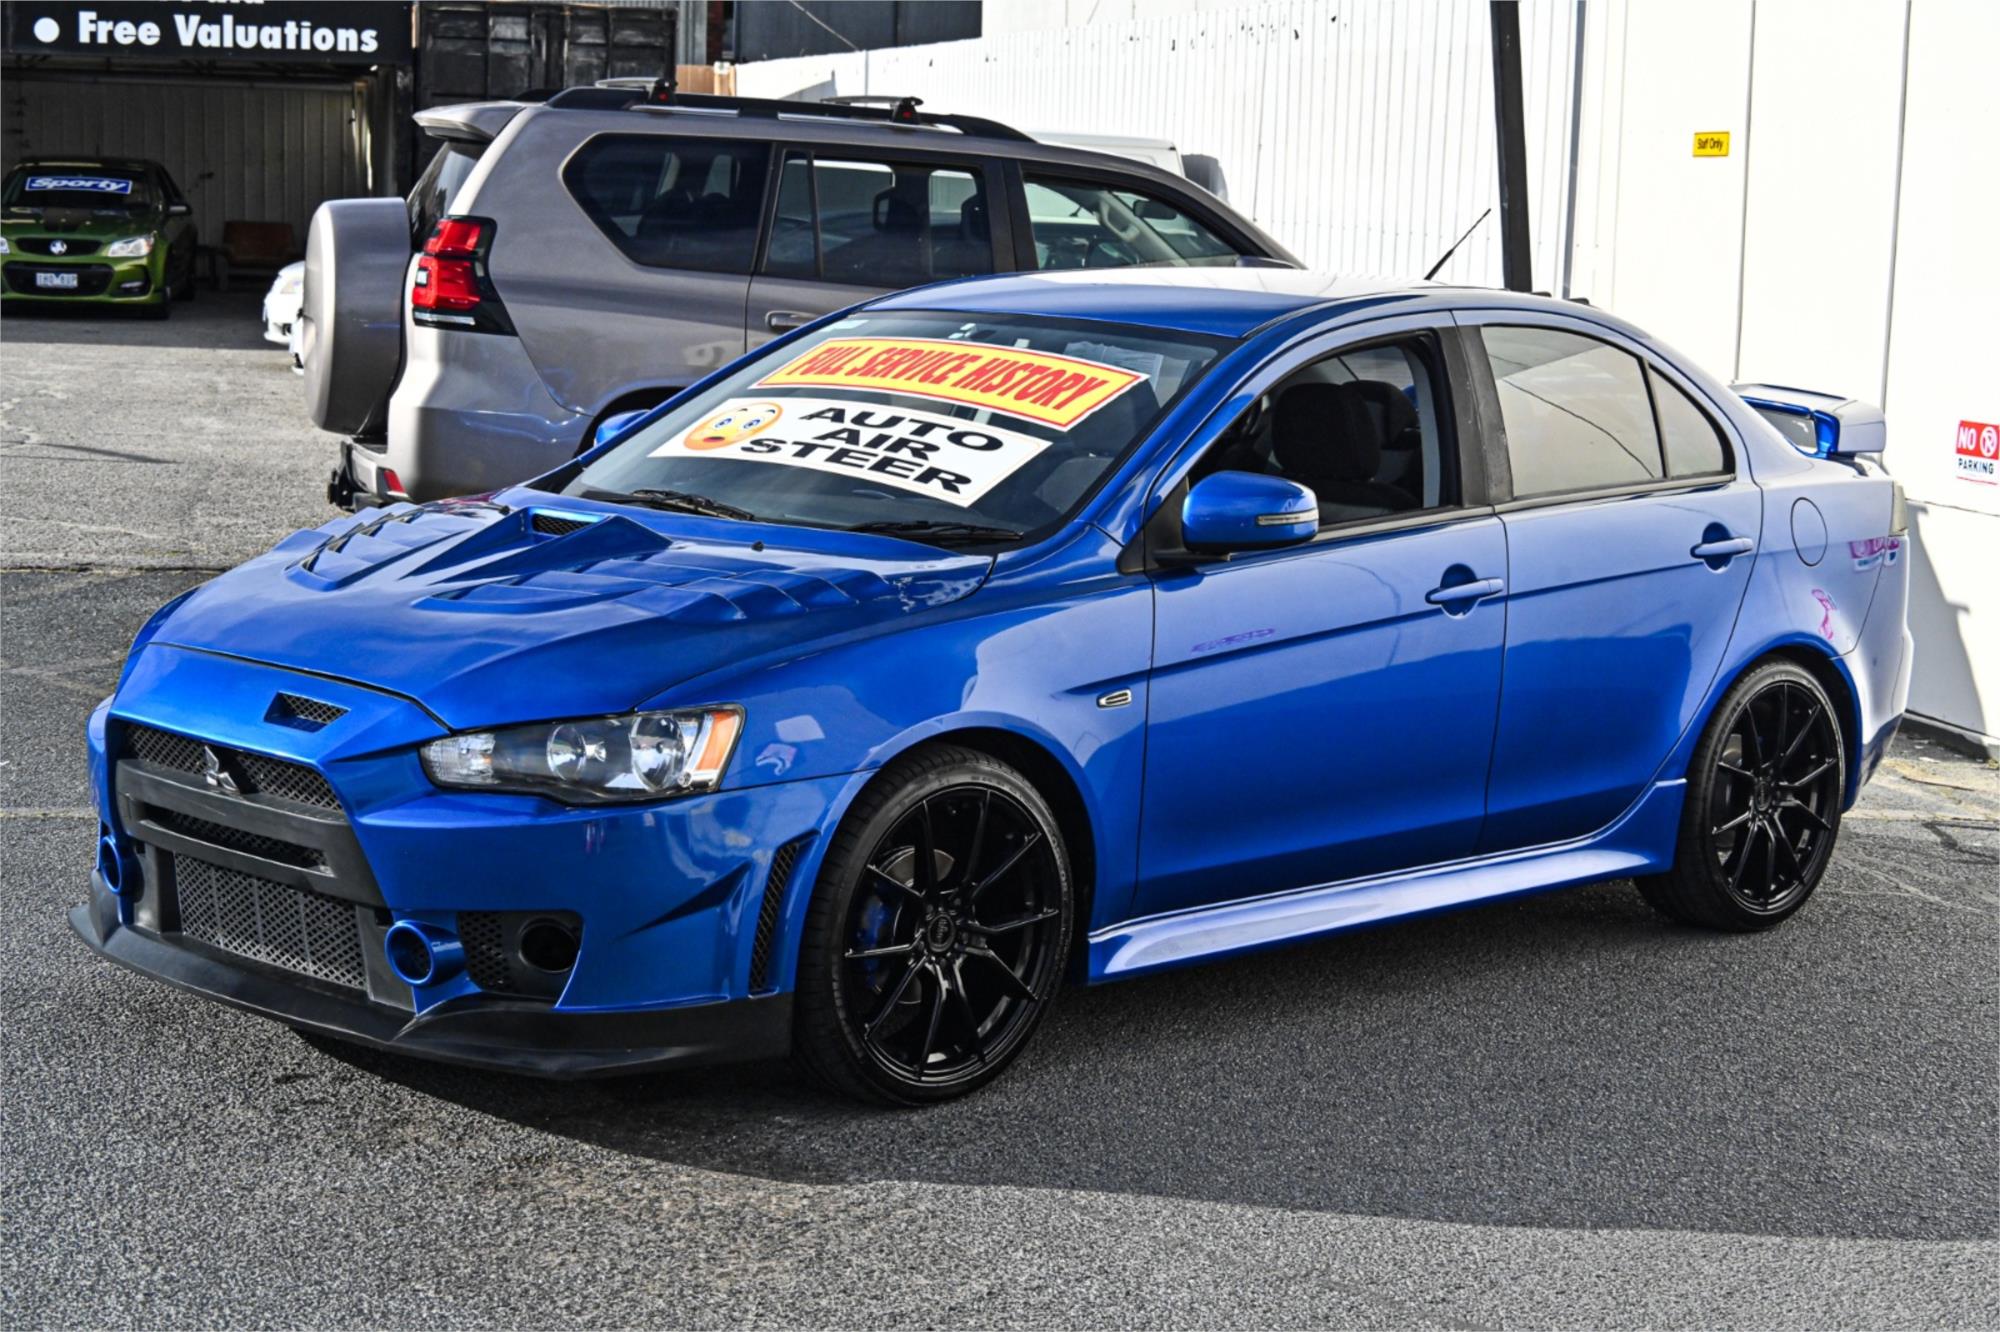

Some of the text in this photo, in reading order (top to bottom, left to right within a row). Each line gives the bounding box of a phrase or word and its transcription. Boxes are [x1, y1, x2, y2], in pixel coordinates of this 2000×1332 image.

[78, 11, 379, 53] Free Valuations
[31, 178, 127, 191] Sporty
[786, 347, 1109, 410] FULL SERVICE HISTORY
[798, 407, 1003, 451] AUTO
[812, 427, 940, 461] AIR
[1958, 426, 1977, 451] NO
[741, 438, 972, 494] STEER
[1958, 457, 1994, 474] PARKING
